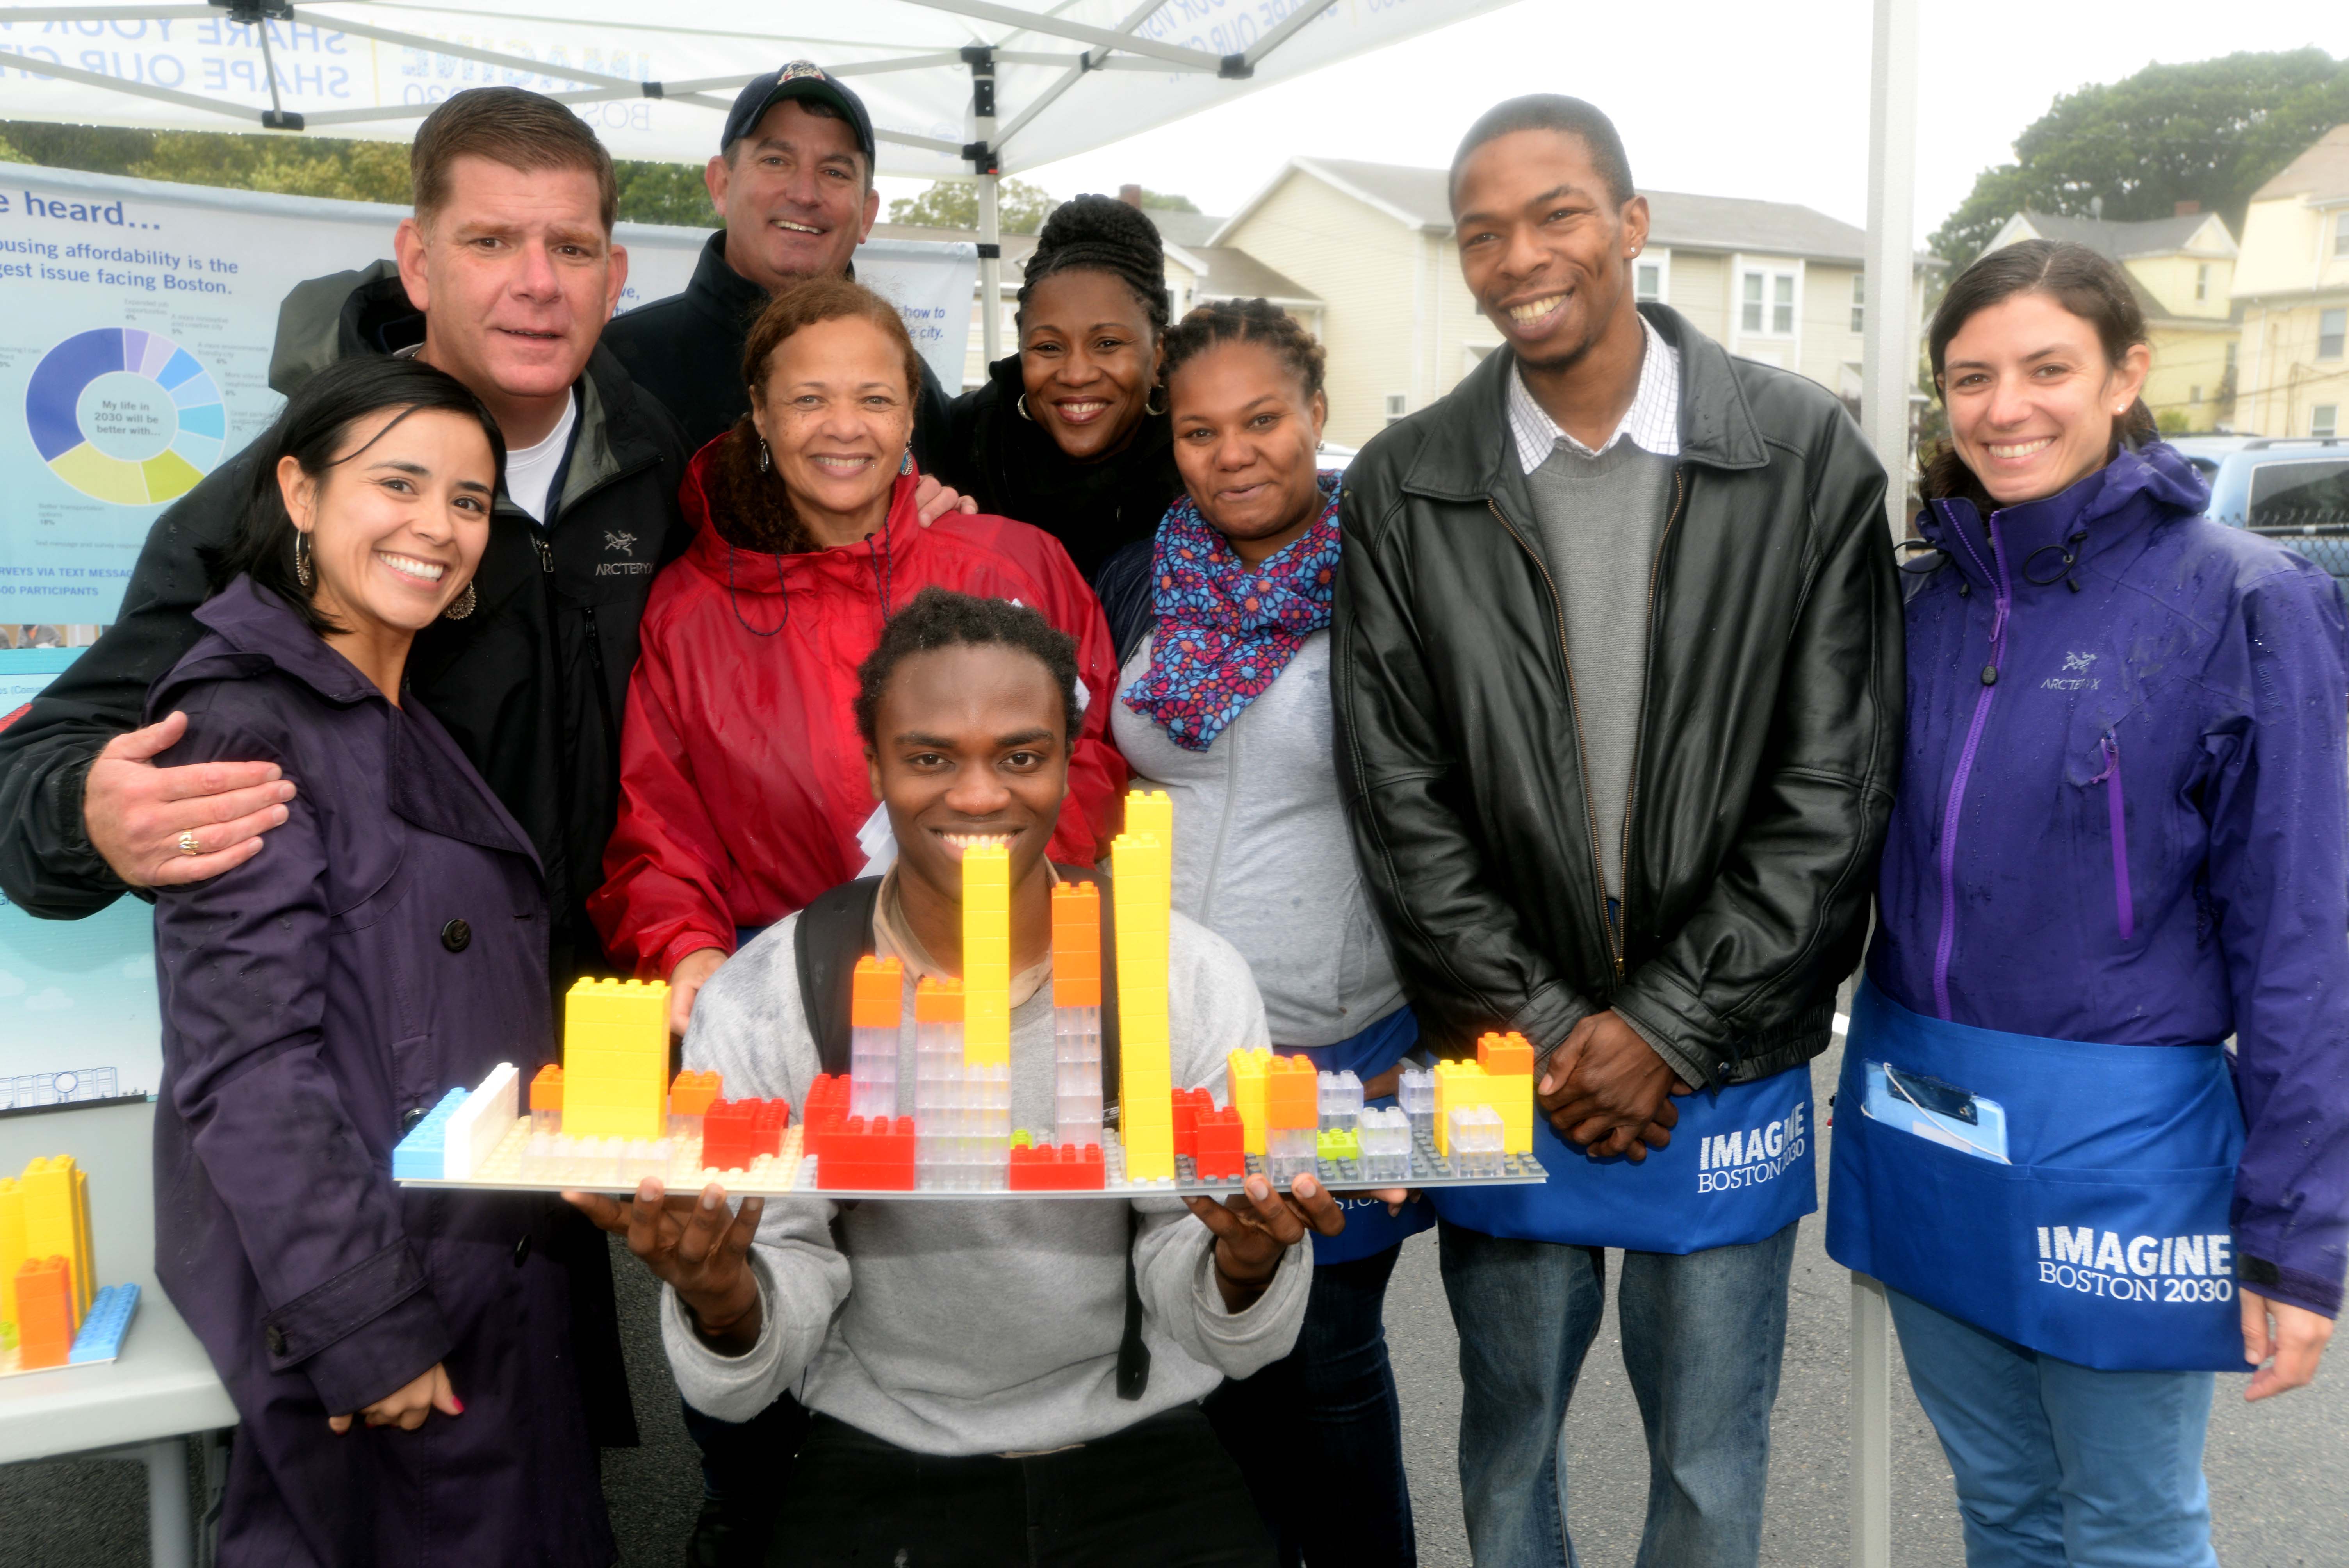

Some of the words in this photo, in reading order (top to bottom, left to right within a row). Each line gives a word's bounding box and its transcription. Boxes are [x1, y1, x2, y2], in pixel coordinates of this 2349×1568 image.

[24, 191, 160, 230] heard...
[0, 238, 59, 259] using
[66, 243, 180, 270] affordability
[188, 255, 202, 270] is
[209, 258, 238, 274] the
[0, 263, 32, 278] est
[40, 263, 90, 283] issue
[97, 268, 156, 292] facing
[164, 274, 232, 294] Boston.
[935, 306, 946, 319] to
[920, 326, 943, 341] city.
[102, 400, 117, 411] My
[120, 401, 136, 410] life
[140, 403, 150, 411] in
[94, 412, 122, 422] 2030
[126, 414, 143, 423] will
[146, 415, 159, 424] be
[96, 424, 126, 434] better
[130, 427, 160, 436] with...
[59, 568, 85, 577] TEXT
[20, 586, 99, 596] PARTICIPANTS
[1697, 1158, 1782, 1193] BOSTON
[2037, 1226, 2232, 1276] IMAGINE
[2037, 1261, 2158, 1301] BOSTON
[2163, 1279, 2233, 1302] 2030
